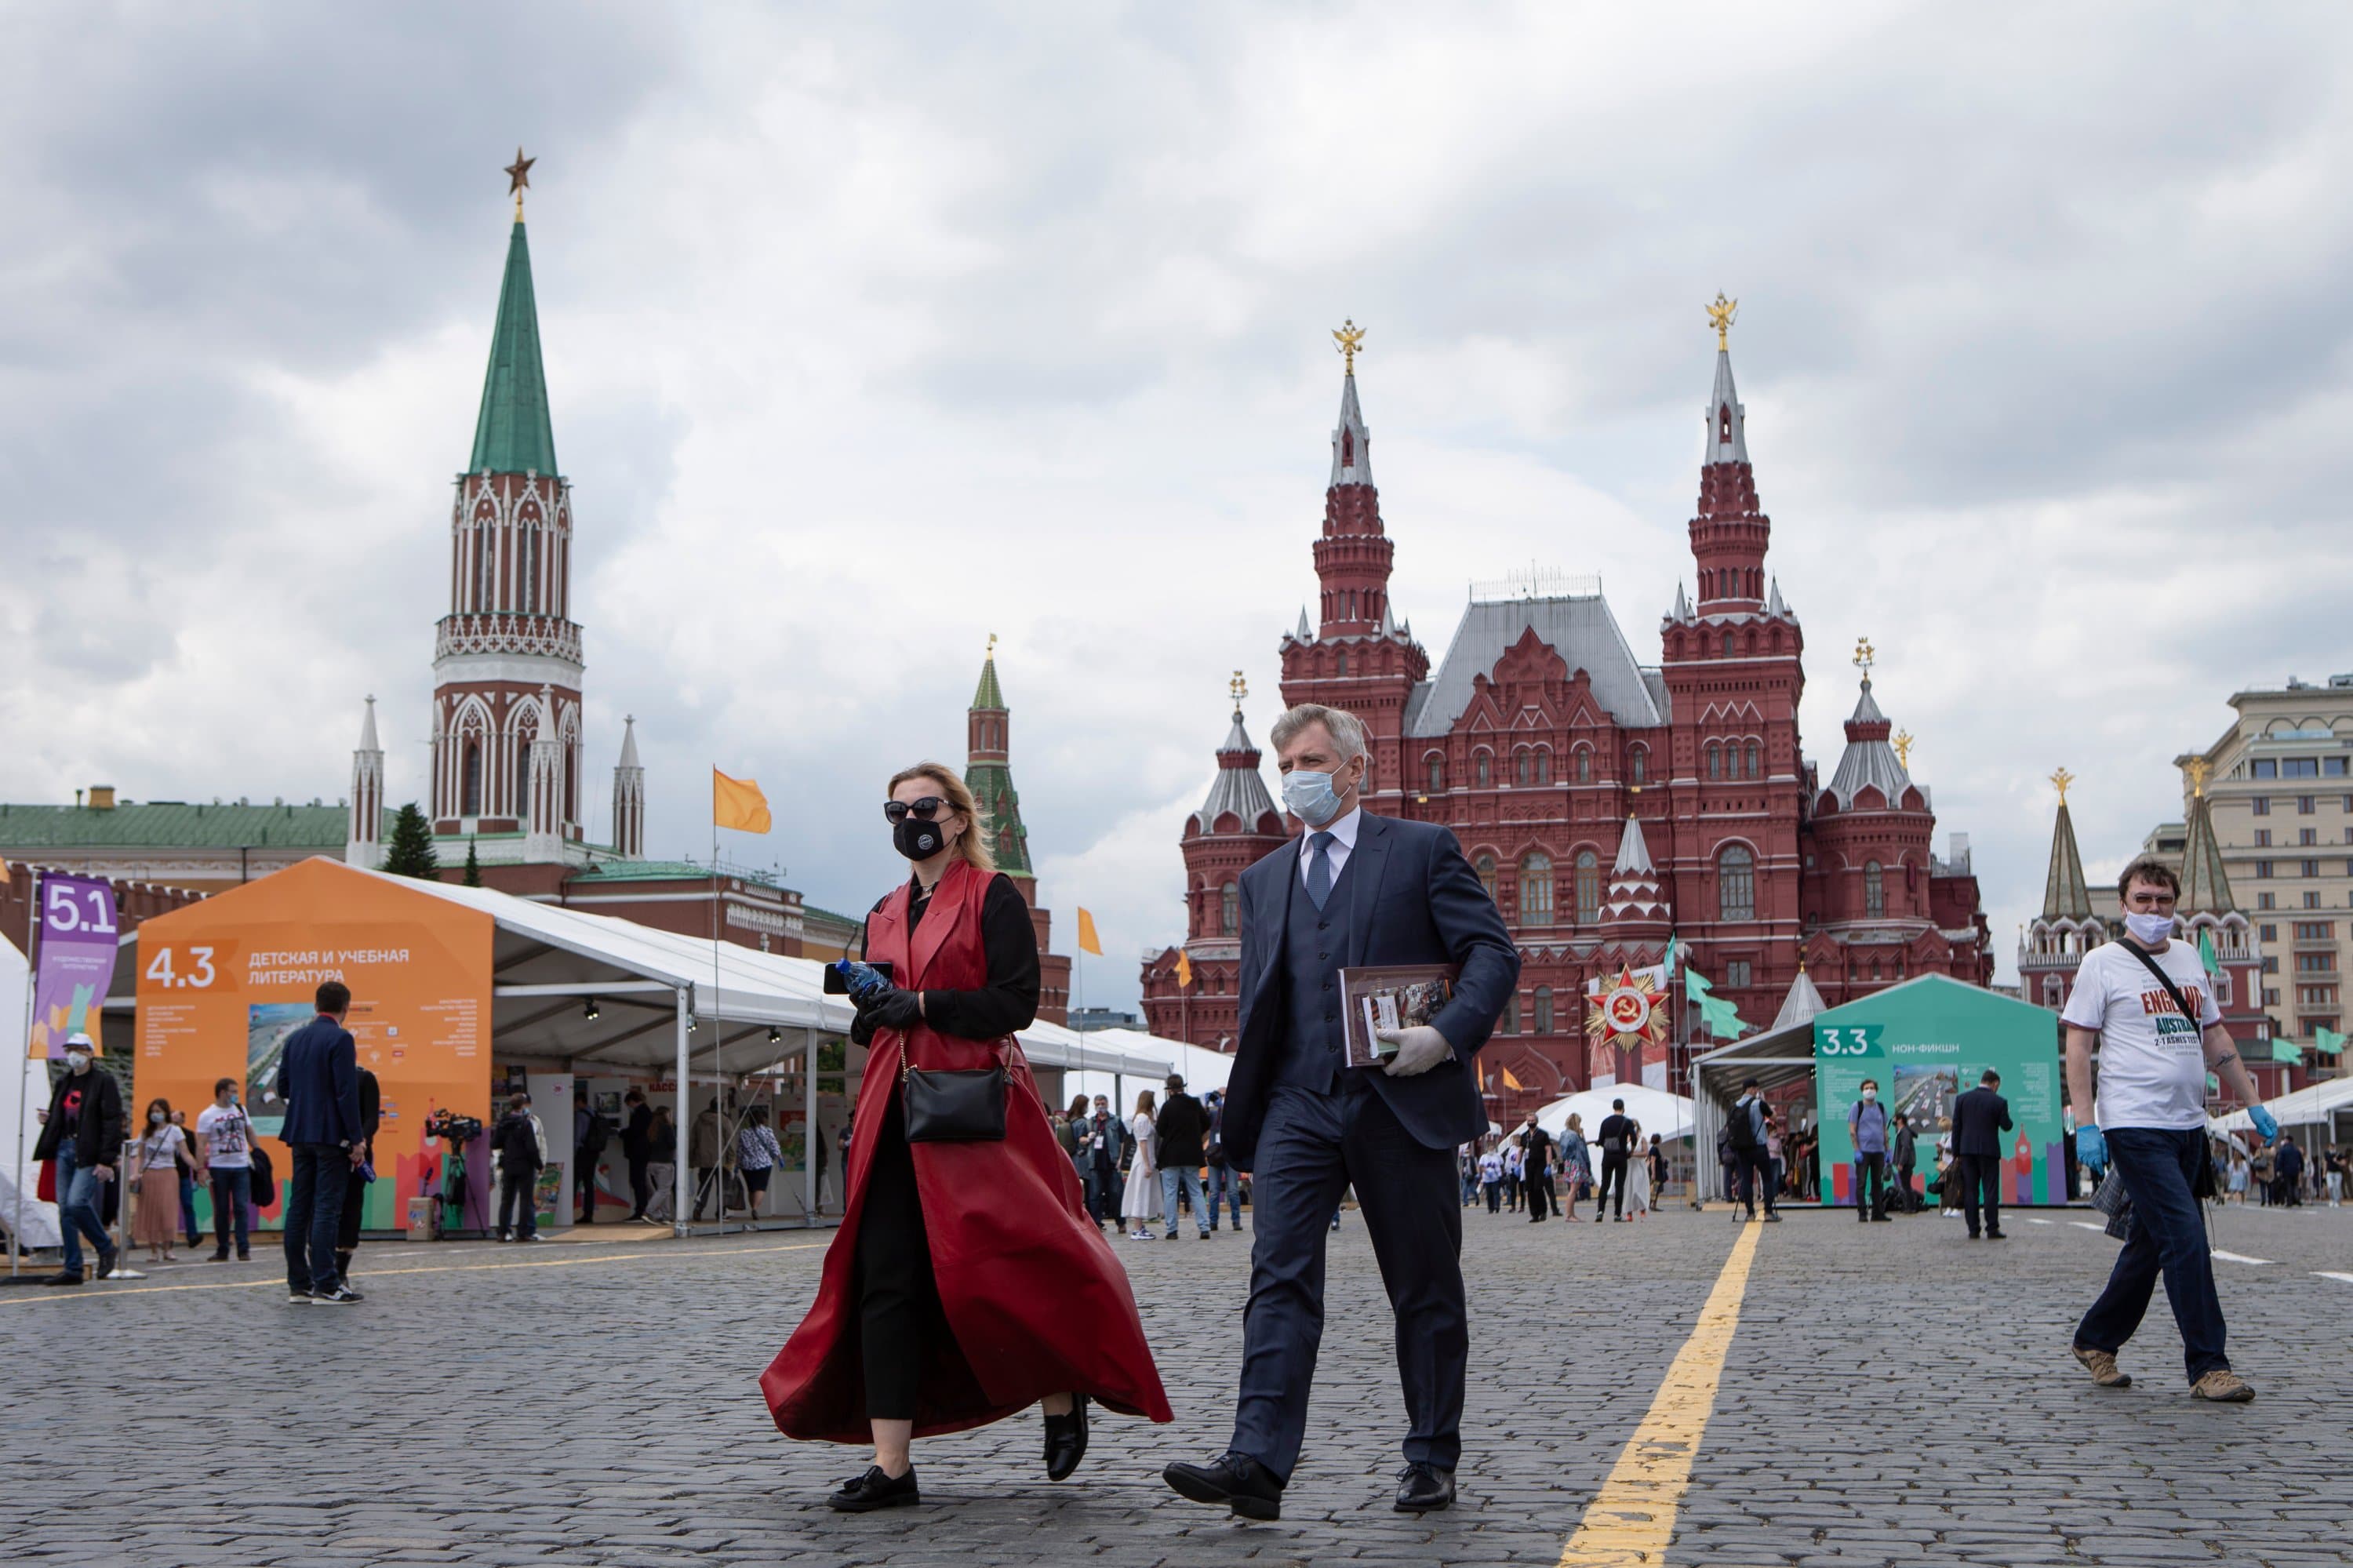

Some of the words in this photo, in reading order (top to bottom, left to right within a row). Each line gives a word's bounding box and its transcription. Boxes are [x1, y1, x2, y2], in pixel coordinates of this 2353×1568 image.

[48, 884, 116, 933] 5.1
[146, 947, 215, 988] 4.3
[249, 951, 318, 968] ДЕТСКАЯ
[322, 951, 333, 964] И
[338, 949, 409, 964] УЧЕБНАЯ
[249, 969, 344, 984] ЛИТЕРАТУРА
[2140, 985, 2203, 1018] ENGLND
[2155, 1017, 2201, 1035] AUSTRA
[1822, 1028, 1867, 1055] 3.3
[1892, 1043, 1959, 1053] НОН-ФИКШН
[649, 1082, 678, 1092] КАСС
